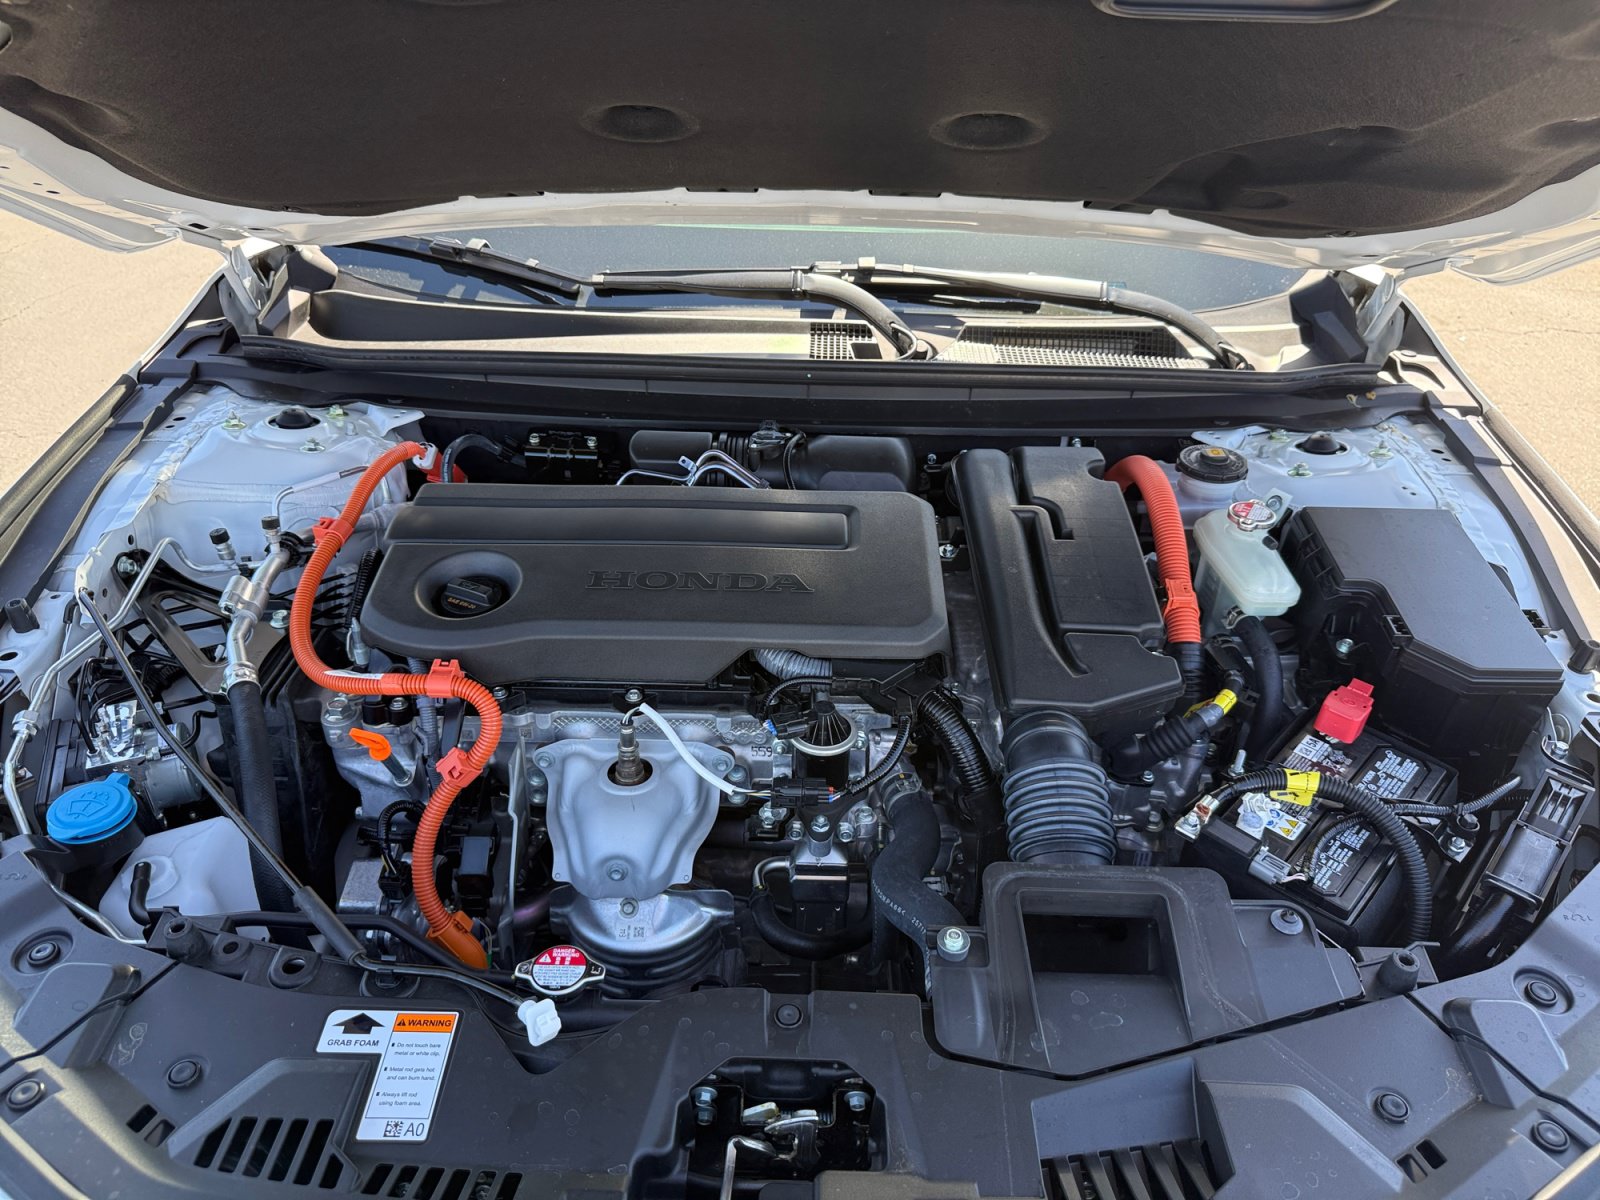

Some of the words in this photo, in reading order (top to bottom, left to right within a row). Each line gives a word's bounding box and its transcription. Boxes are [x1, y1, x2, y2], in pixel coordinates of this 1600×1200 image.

[585, 569, 815, 593] HONDA
[751, 745, 773, 757] 559
[408, 1019, 451, 1027] WARNING
[354, 1039, 379, 1047] FOAM
[404, 1122, 425, 1137] A0
